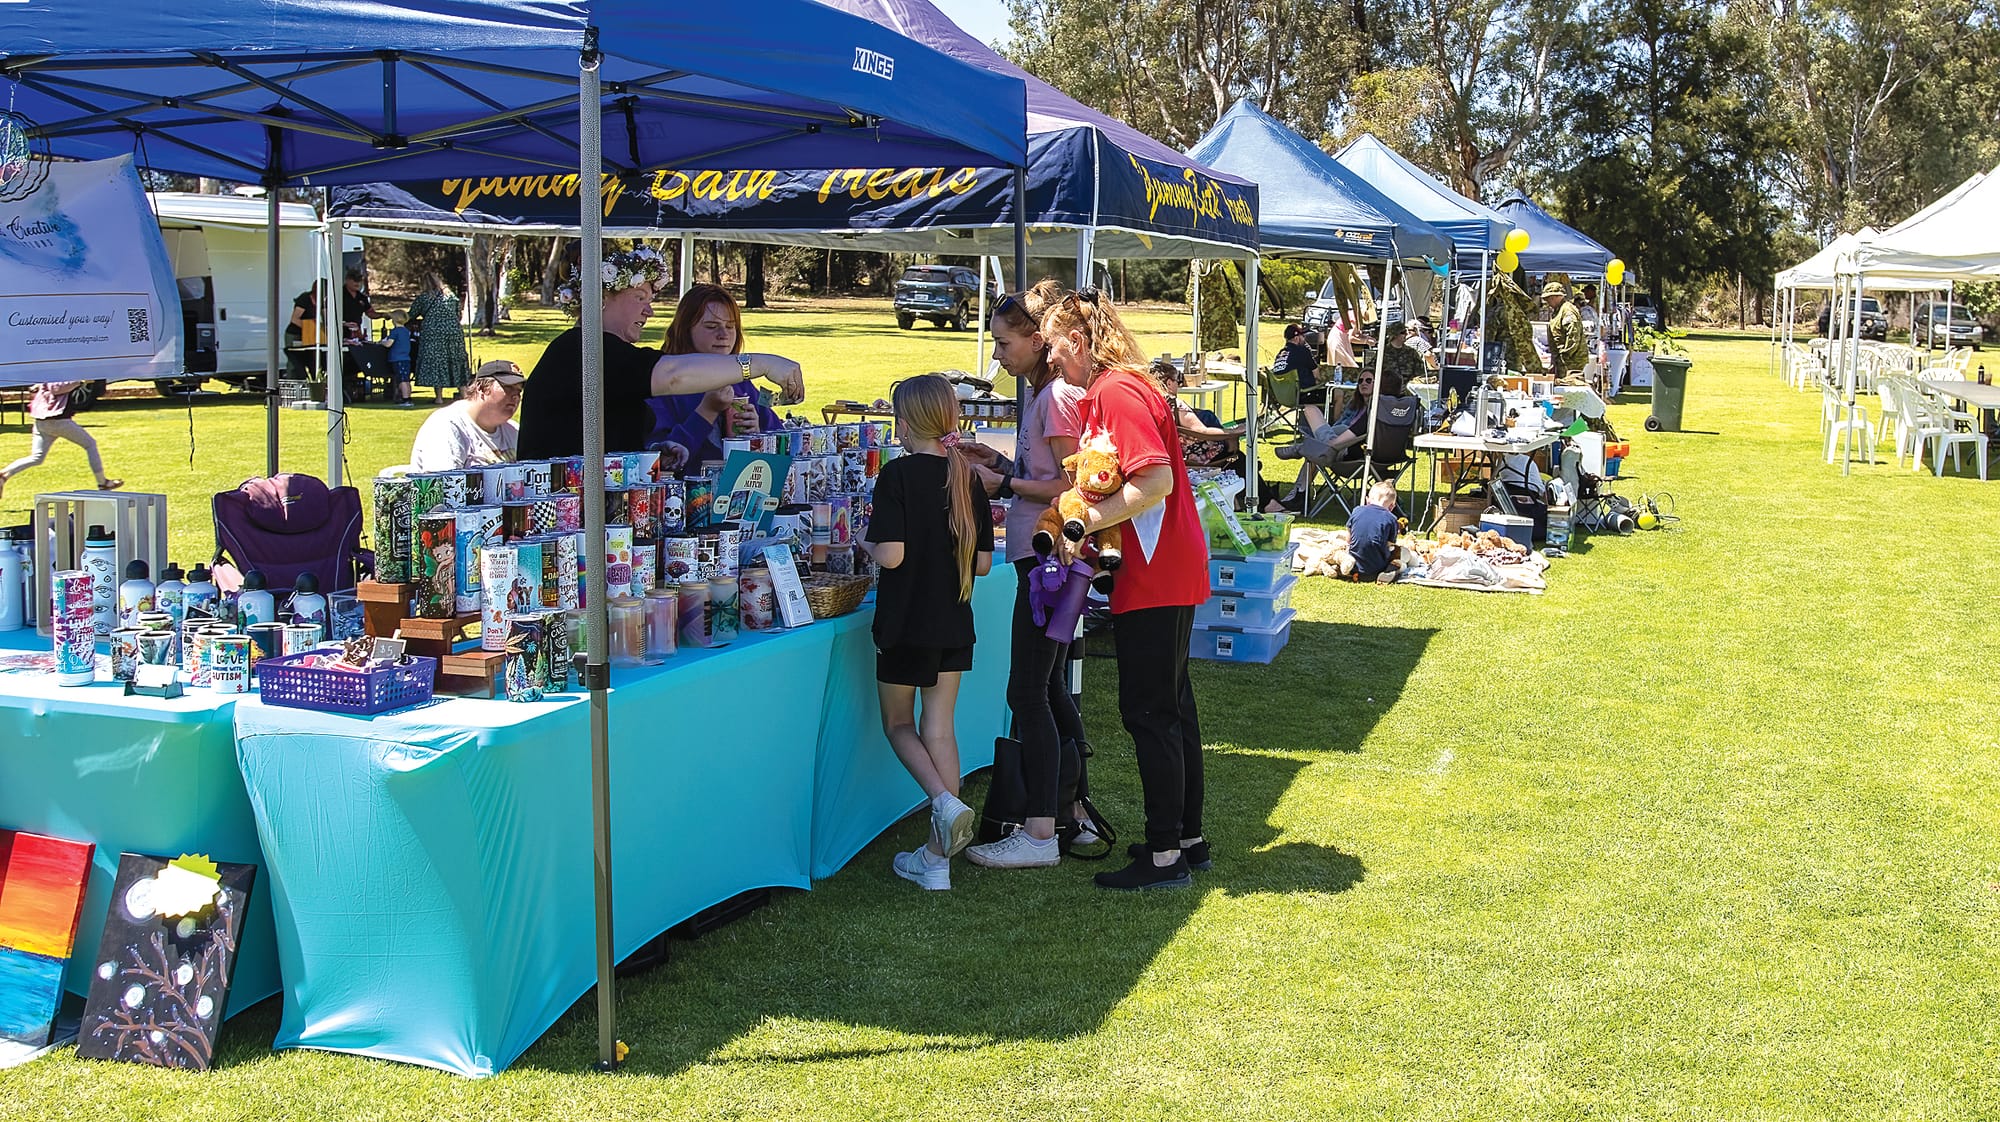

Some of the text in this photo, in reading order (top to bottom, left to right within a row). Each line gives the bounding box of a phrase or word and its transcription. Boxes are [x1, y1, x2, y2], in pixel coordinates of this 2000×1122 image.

[853, 48, 894, 79] KINGS
[6, 215, 62, 241] Creative
[8, 309, 115, 330] Customised your way!
[523, 468, 551, 488] Cor
[743, 480, 763, 488] MATCH
